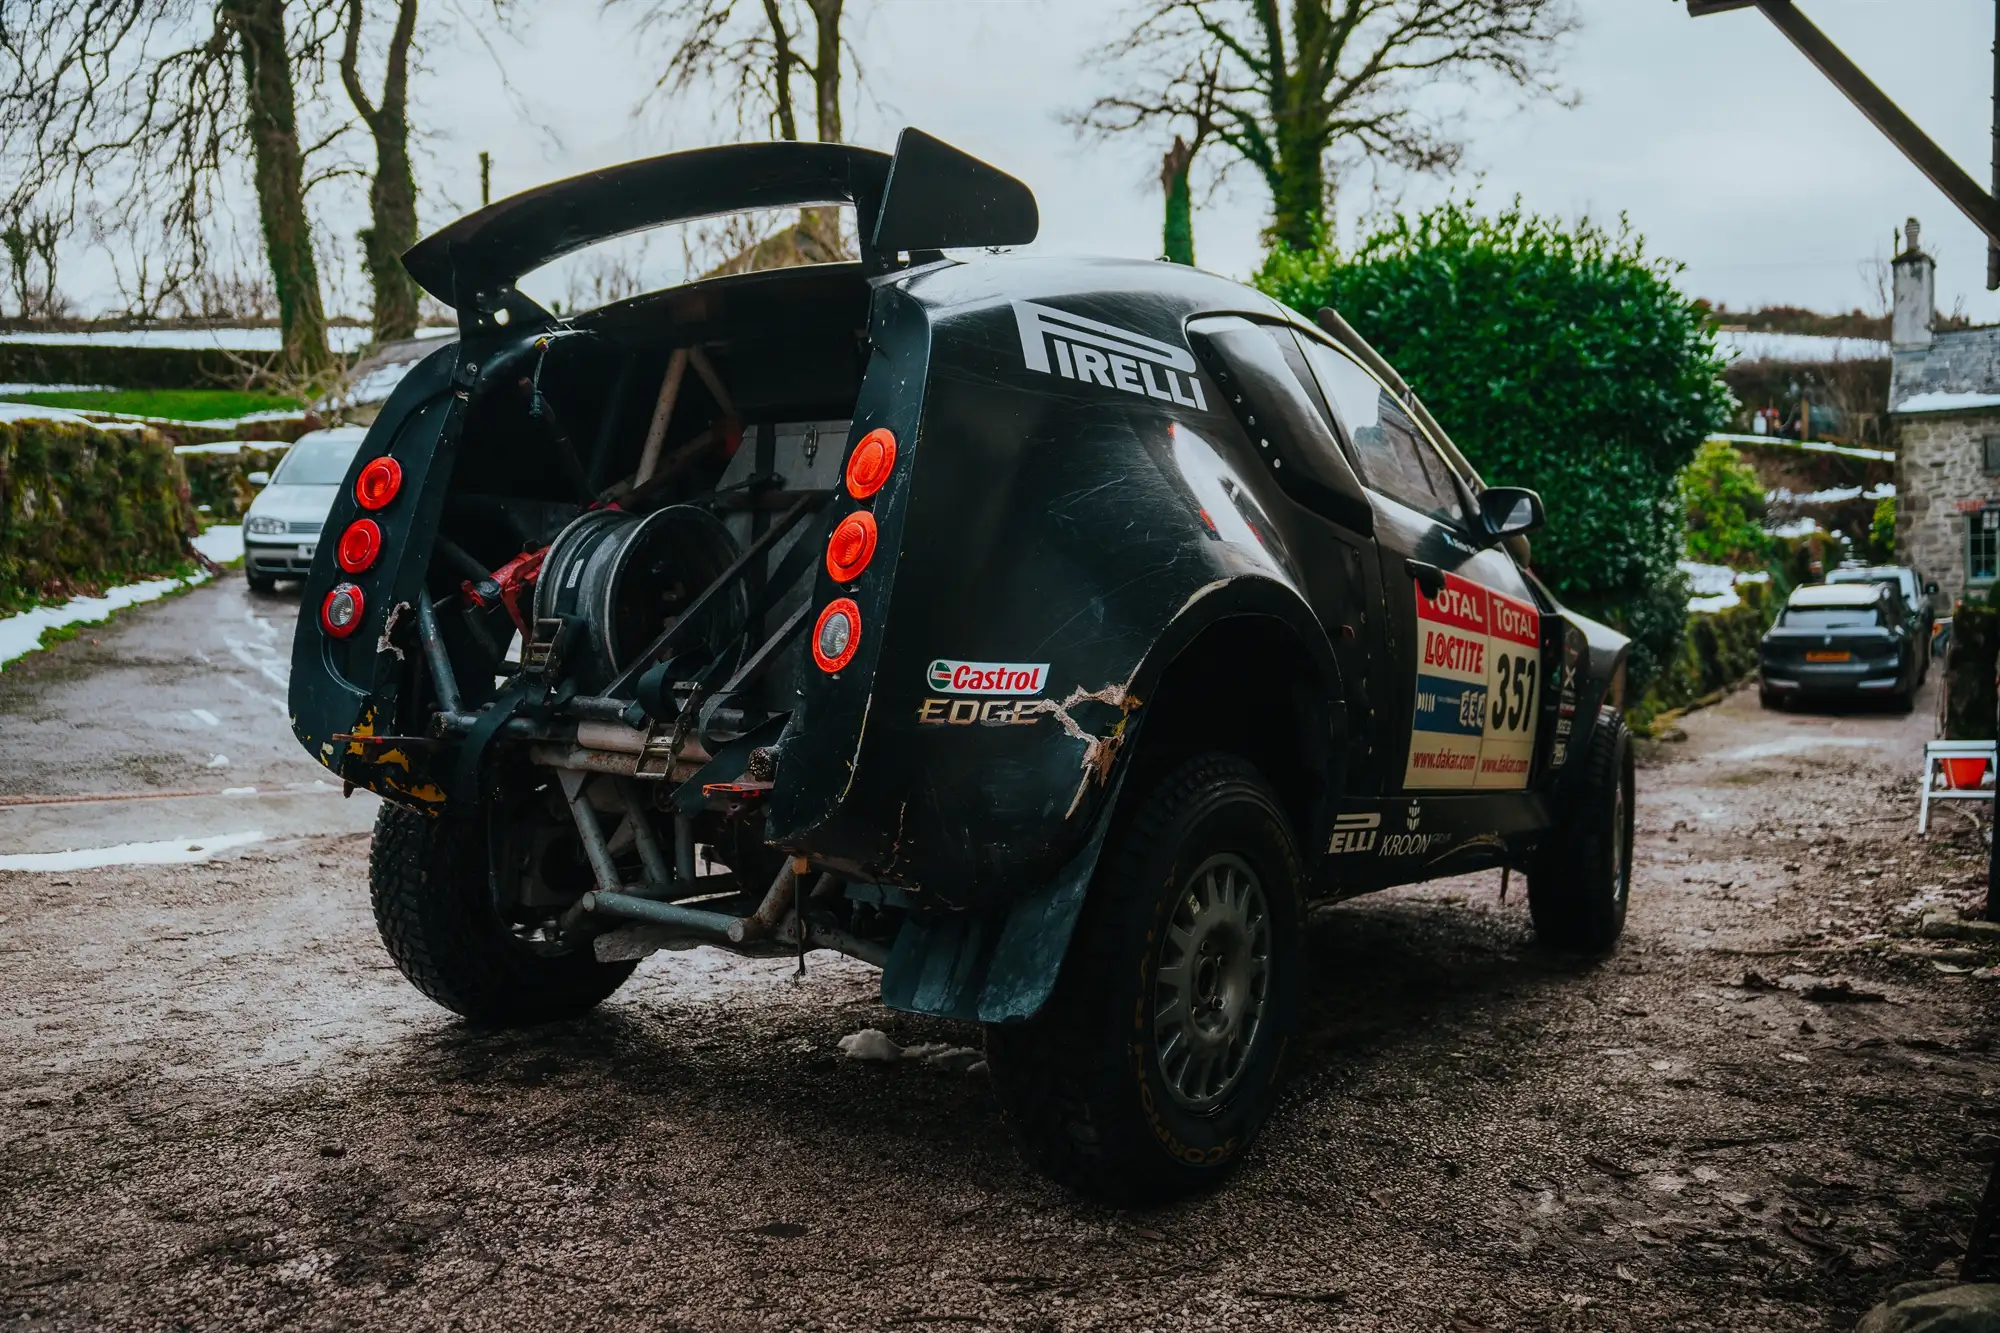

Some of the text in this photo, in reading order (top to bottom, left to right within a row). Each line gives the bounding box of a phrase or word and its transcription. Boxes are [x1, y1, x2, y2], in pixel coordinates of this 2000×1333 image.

[1010, 300, 1208, 411] PIRELLI
[1429, 589, 1483, 624] OTAL
[1493, 598, 1536, 640] TOTAL
[1424, 631, 1484, 674] LOCTITE
[953, 665, 1040, 690] Castrol
[1492, 653, 1535, 733] 351
[917, 698, 1044, 726] EDGE
[1413, 748, 1475, 771] www.dakar.com
[1480, 754, 1528, 773] www.dakar.com
[1379, 834, 1431, 857] KROON
